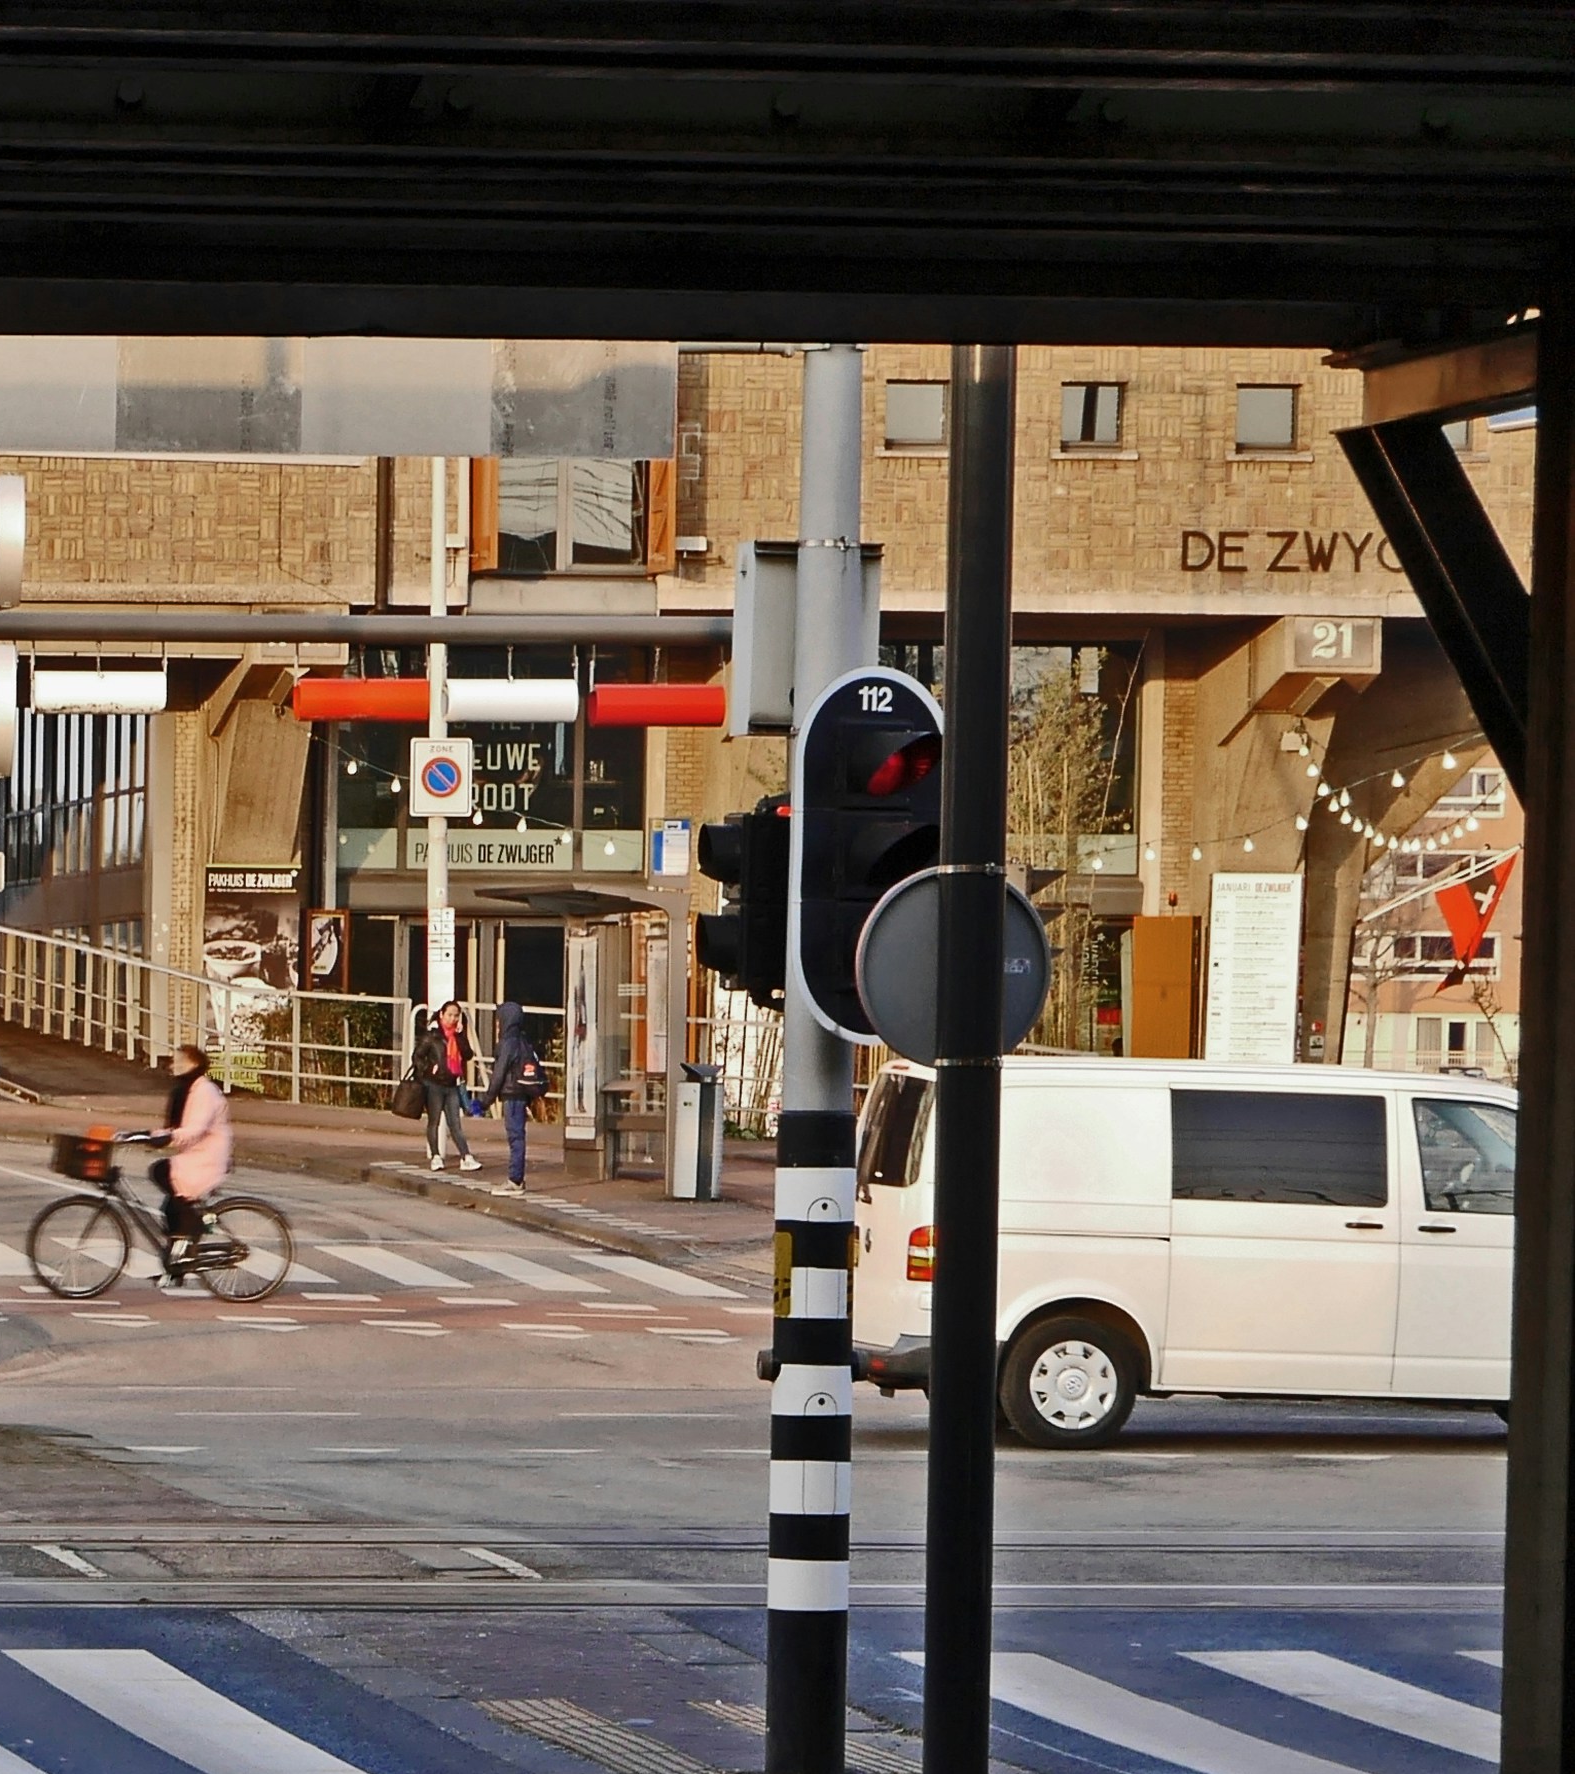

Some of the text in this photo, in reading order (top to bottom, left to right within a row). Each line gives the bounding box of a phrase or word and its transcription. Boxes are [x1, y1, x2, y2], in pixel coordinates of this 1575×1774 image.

[1181, 531, 1249, 572] DE
[1311, 621, 1353, 659] 21
[858, 685, 893, 712] 112
[429, 745, 454, 753] ZONE
[478, 843, 494, 863] DE
[497, 844, 554, 864] ZWIJGER
[208, 873, 244, 887] PAKHUIS
[245, 873, 256, 887] DE
[1216, 882, 1251, 892] JANUARI
